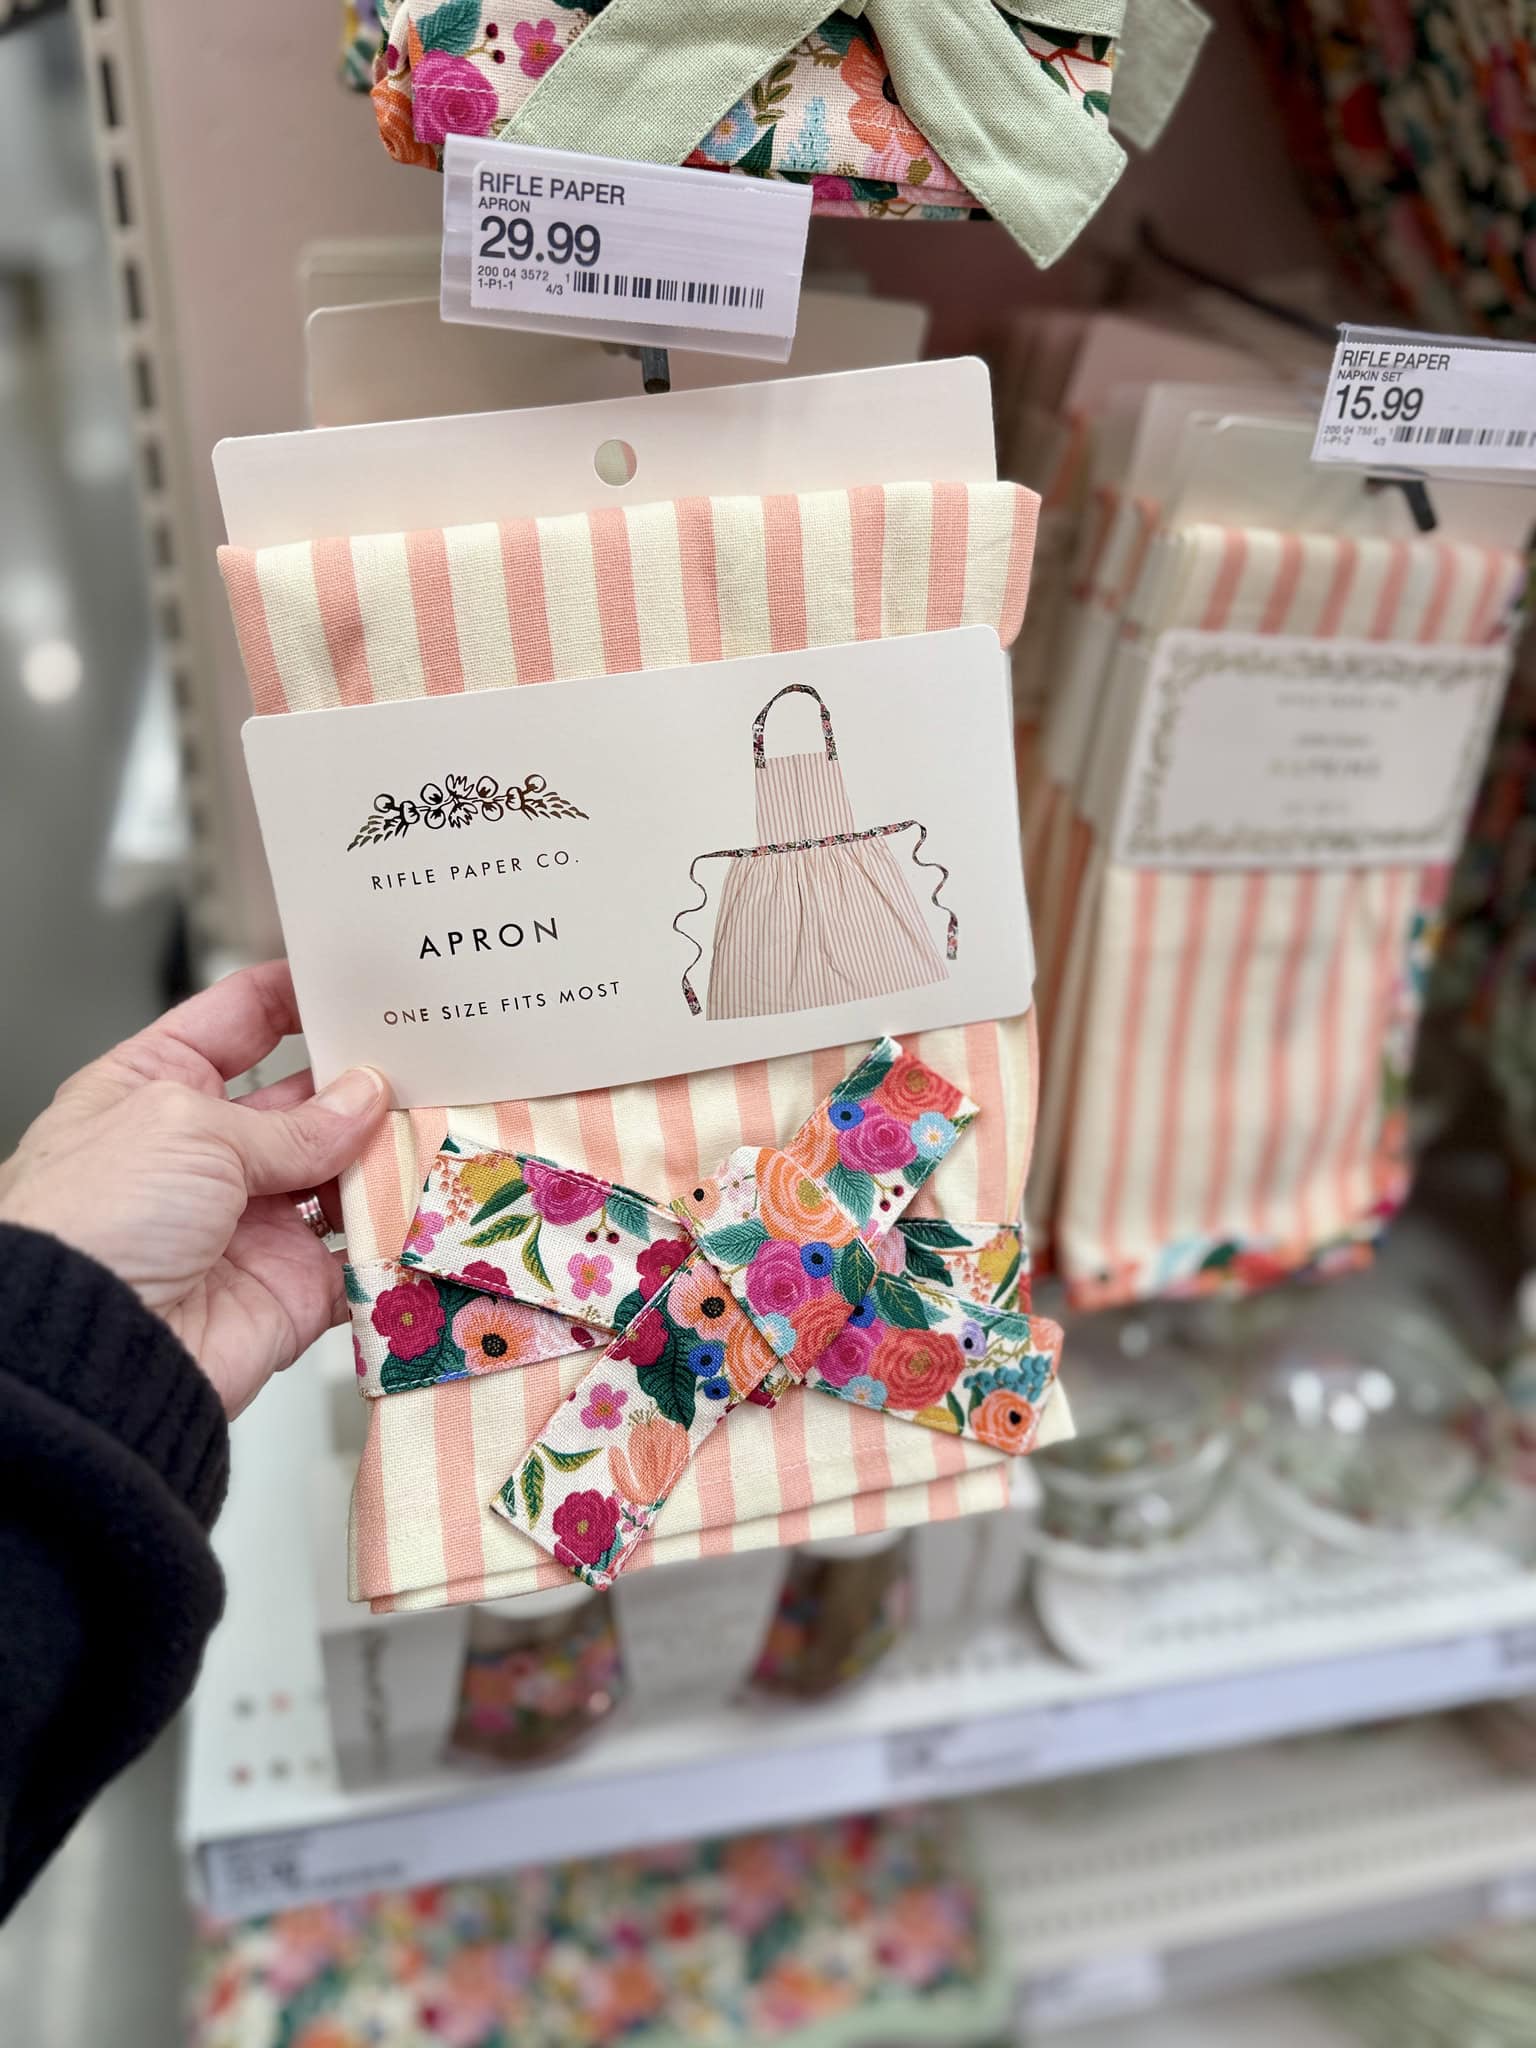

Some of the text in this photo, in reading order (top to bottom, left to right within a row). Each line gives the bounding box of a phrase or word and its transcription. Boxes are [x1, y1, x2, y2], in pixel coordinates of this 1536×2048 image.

[478, 196, 531, 213] APRON
[479, 171, 625, 205] RIFLE PAPER
[480, 215, 601, 266] 29.99
[477, 265, 499, 277] 200
[502, 267, 516, 279] 04
[520, 268, 549, 281] 3572
[477, 277, 563, 296] 1-P1-1 4/3
[1337, 369, 1402, 383] NAPKIN SET
[1341, 350, 1450, 371] RIFLE PAPER
[1336, 384, 1424, 422] 15.99
[371, 850, 580, 891] RIFLE PAPER CO.
[419, 917, 558, 960] APRON
[383, 981, 621, 1026] ONE SIZE FITS MOST
